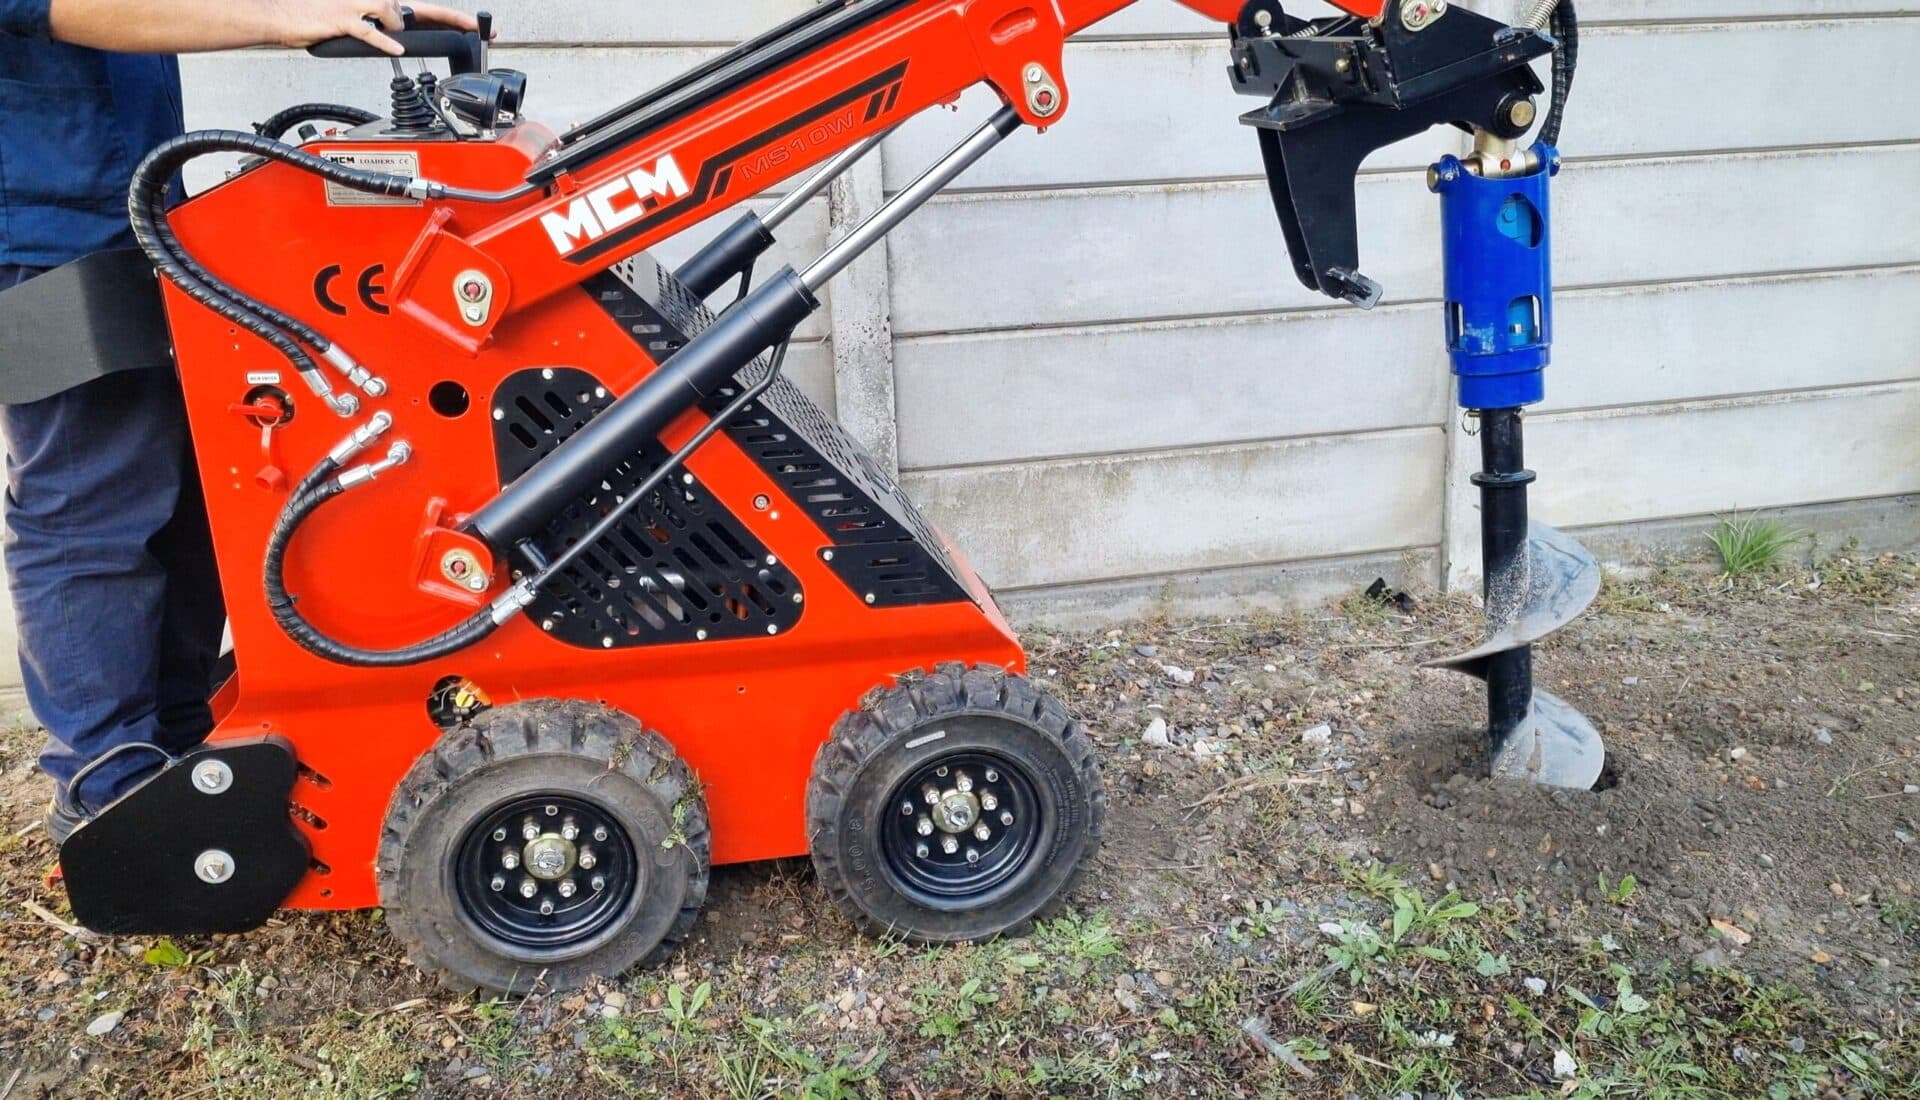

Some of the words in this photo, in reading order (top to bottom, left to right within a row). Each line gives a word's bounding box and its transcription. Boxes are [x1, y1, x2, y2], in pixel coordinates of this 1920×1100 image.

[330, 156, 355, 165] MCM
[741, 111, 854, 180] MS10W
[539, 152, 690, 255] MCM
[313, 263, 391, 316] CE
